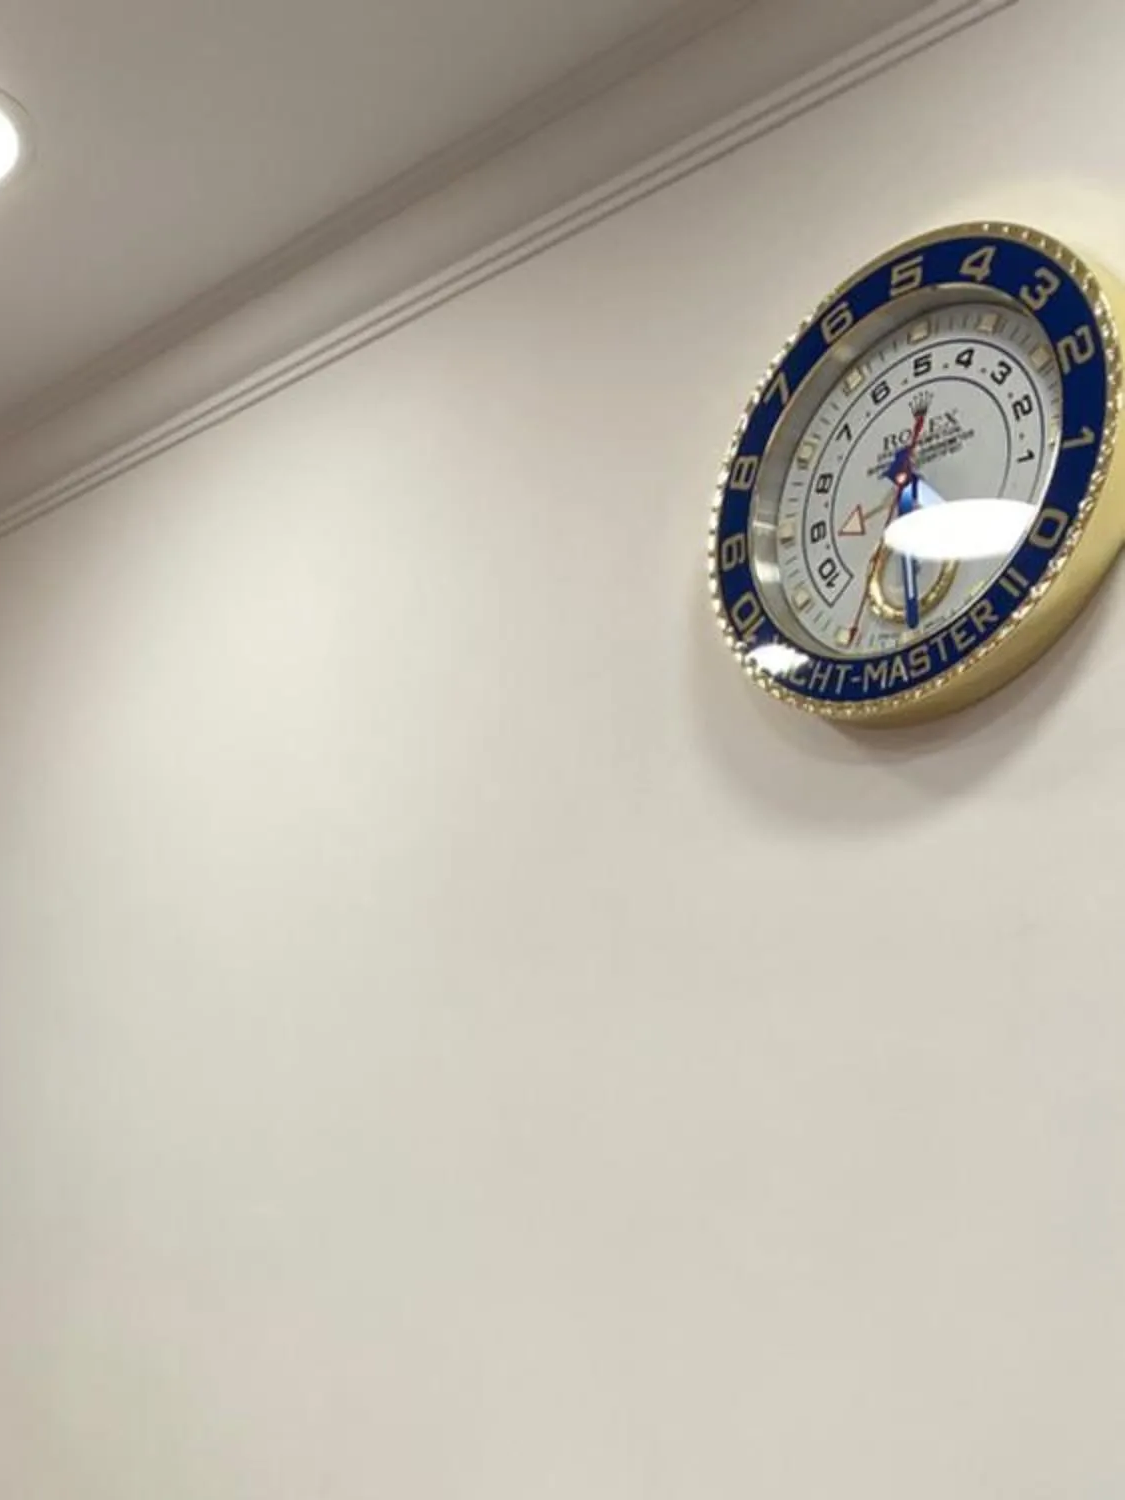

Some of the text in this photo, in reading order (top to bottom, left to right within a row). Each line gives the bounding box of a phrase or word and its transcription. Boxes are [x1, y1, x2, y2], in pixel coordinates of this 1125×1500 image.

[889, 256, 924, 296] 5
[960, 245, 996, 284] 4
[1020, 268, 1061, 311] 3
[820, 303, 854, 345] 6
[913, 353, 934, 377] 5
[954, 347, 975, 369] 4
[1057, 330, 1095, 371] 2
[762, 372, 793, 404] 7
[989, 361, 1013, 384] 3
[870, 381, 892, 405] 6
[1012, 393, 1033, 418] 2
[834, 423, 854, 445] 7
[883, 410, 961, 451] ROEX
[1061, 426, 1096, 450] 1
[729, 455, 758, 492] 8
[1015, 450, 1035, 466] 1
[815, 472, 836, 494] 8
[809, 521, 828, 545] 9
[1030, 508, 1069, 550] 0
[719, 534, 747, 570] 9
[817, 559, 840, 589] 10
[768, 599, 1000, 695] CHT-MASTER
